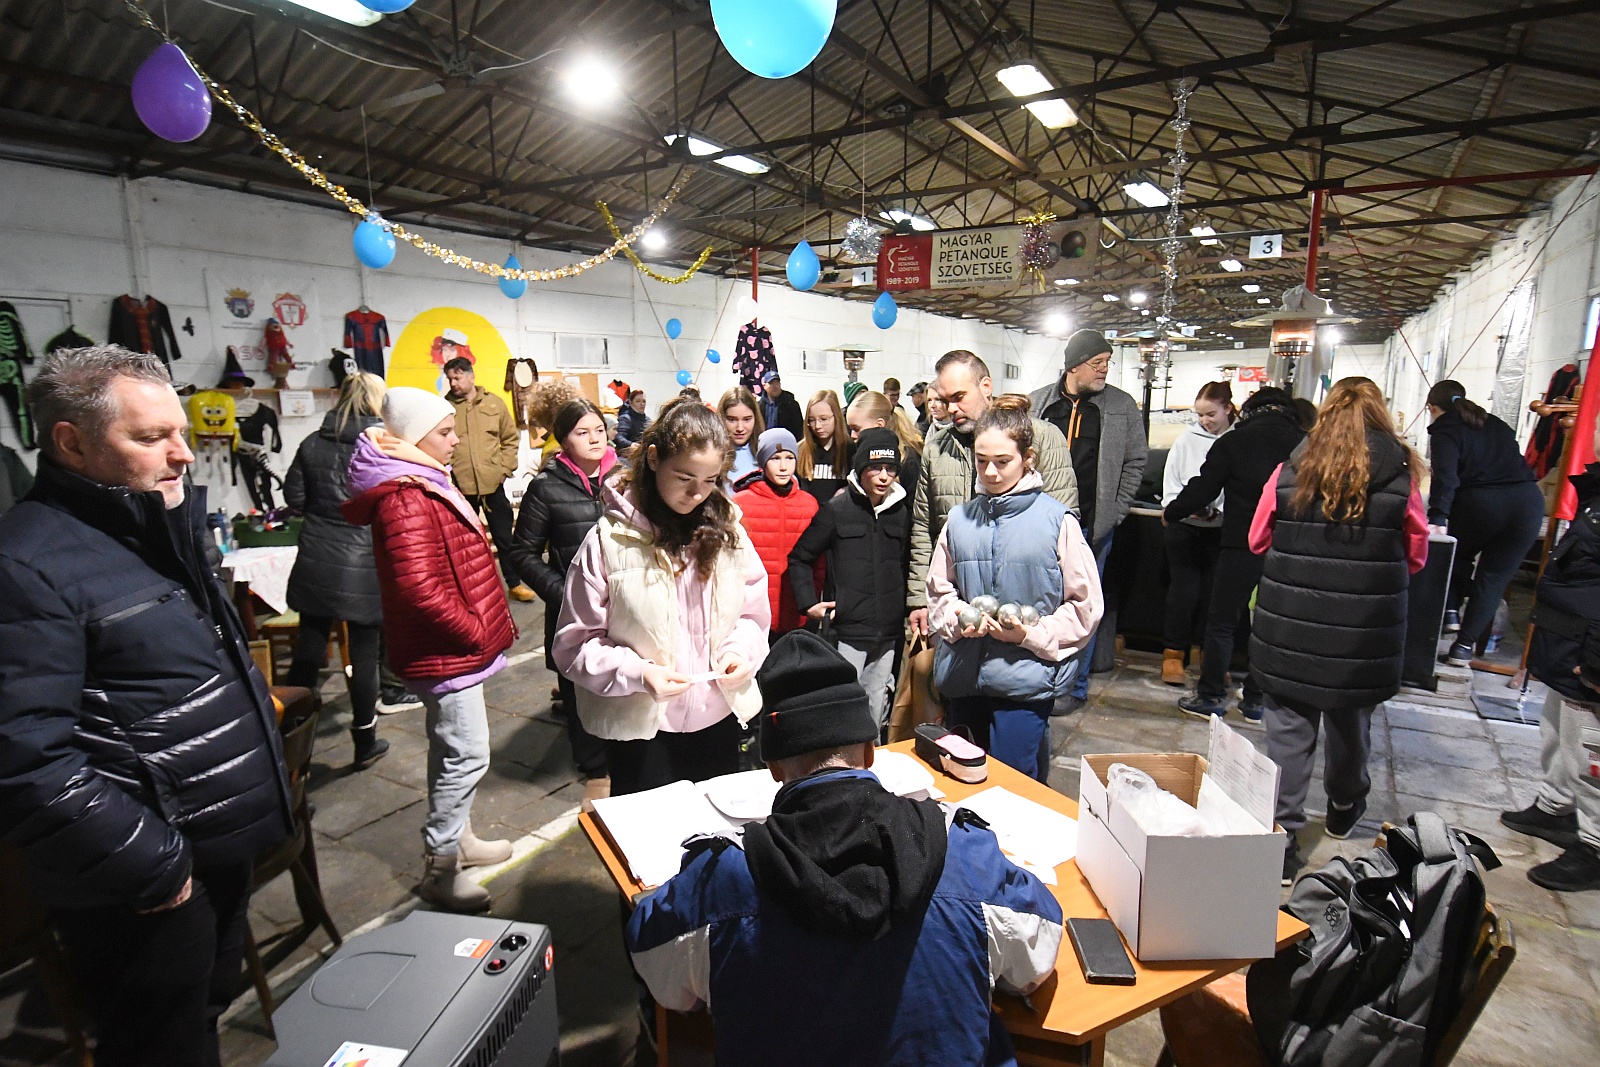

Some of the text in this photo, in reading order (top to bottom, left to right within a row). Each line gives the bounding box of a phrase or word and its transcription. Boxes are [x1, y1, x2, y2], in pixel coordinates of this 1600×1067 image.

[940, 233, 992, 248] MAGYAR
[1262, 240, 1273, 254] 3
[939, 246, 1009, 262] PETANQUE
[861, 271, 866, 282] 1
[886, 276, 920, 285] 1989-2019
